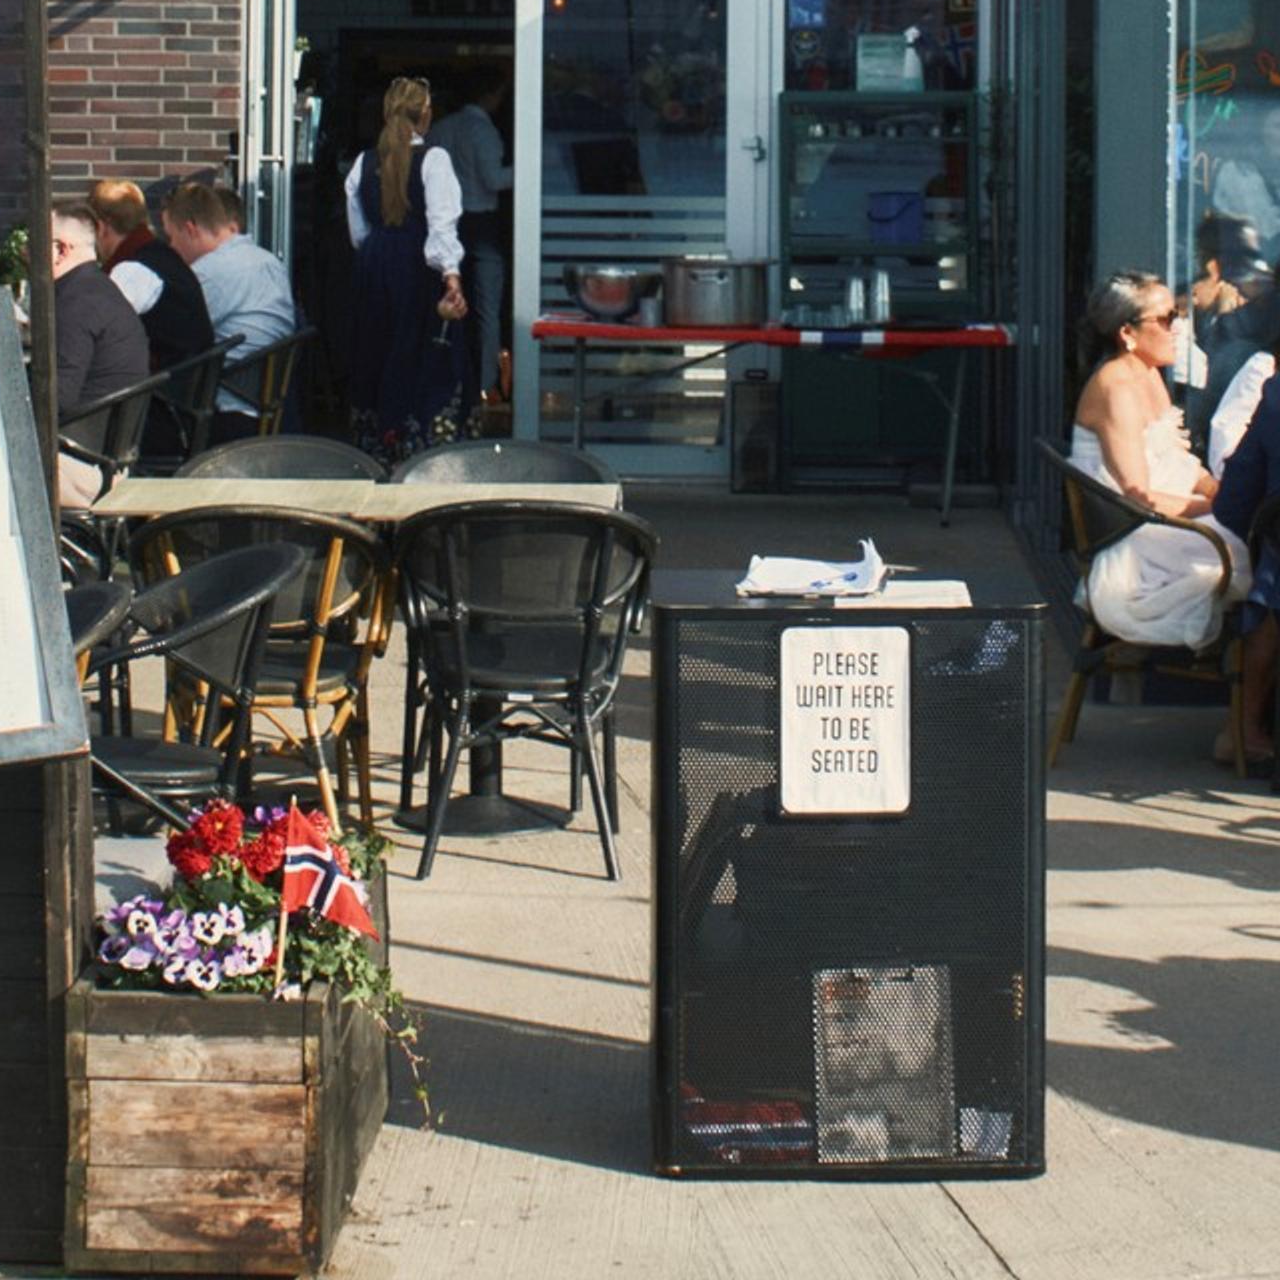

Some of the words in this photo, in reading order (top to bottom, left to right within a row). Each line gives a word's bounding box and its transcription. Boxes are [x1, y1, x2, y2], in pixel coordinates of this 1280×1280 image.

[812, 651, 879, 676] PLEASE
[796, 685, 843, 708] WAIT
[851, 685, 895, 709] HERE
[821, 716, 843, 741] TO
[849, 717, 871, 741] BE
[811, 749, 879, 774] SEATED
